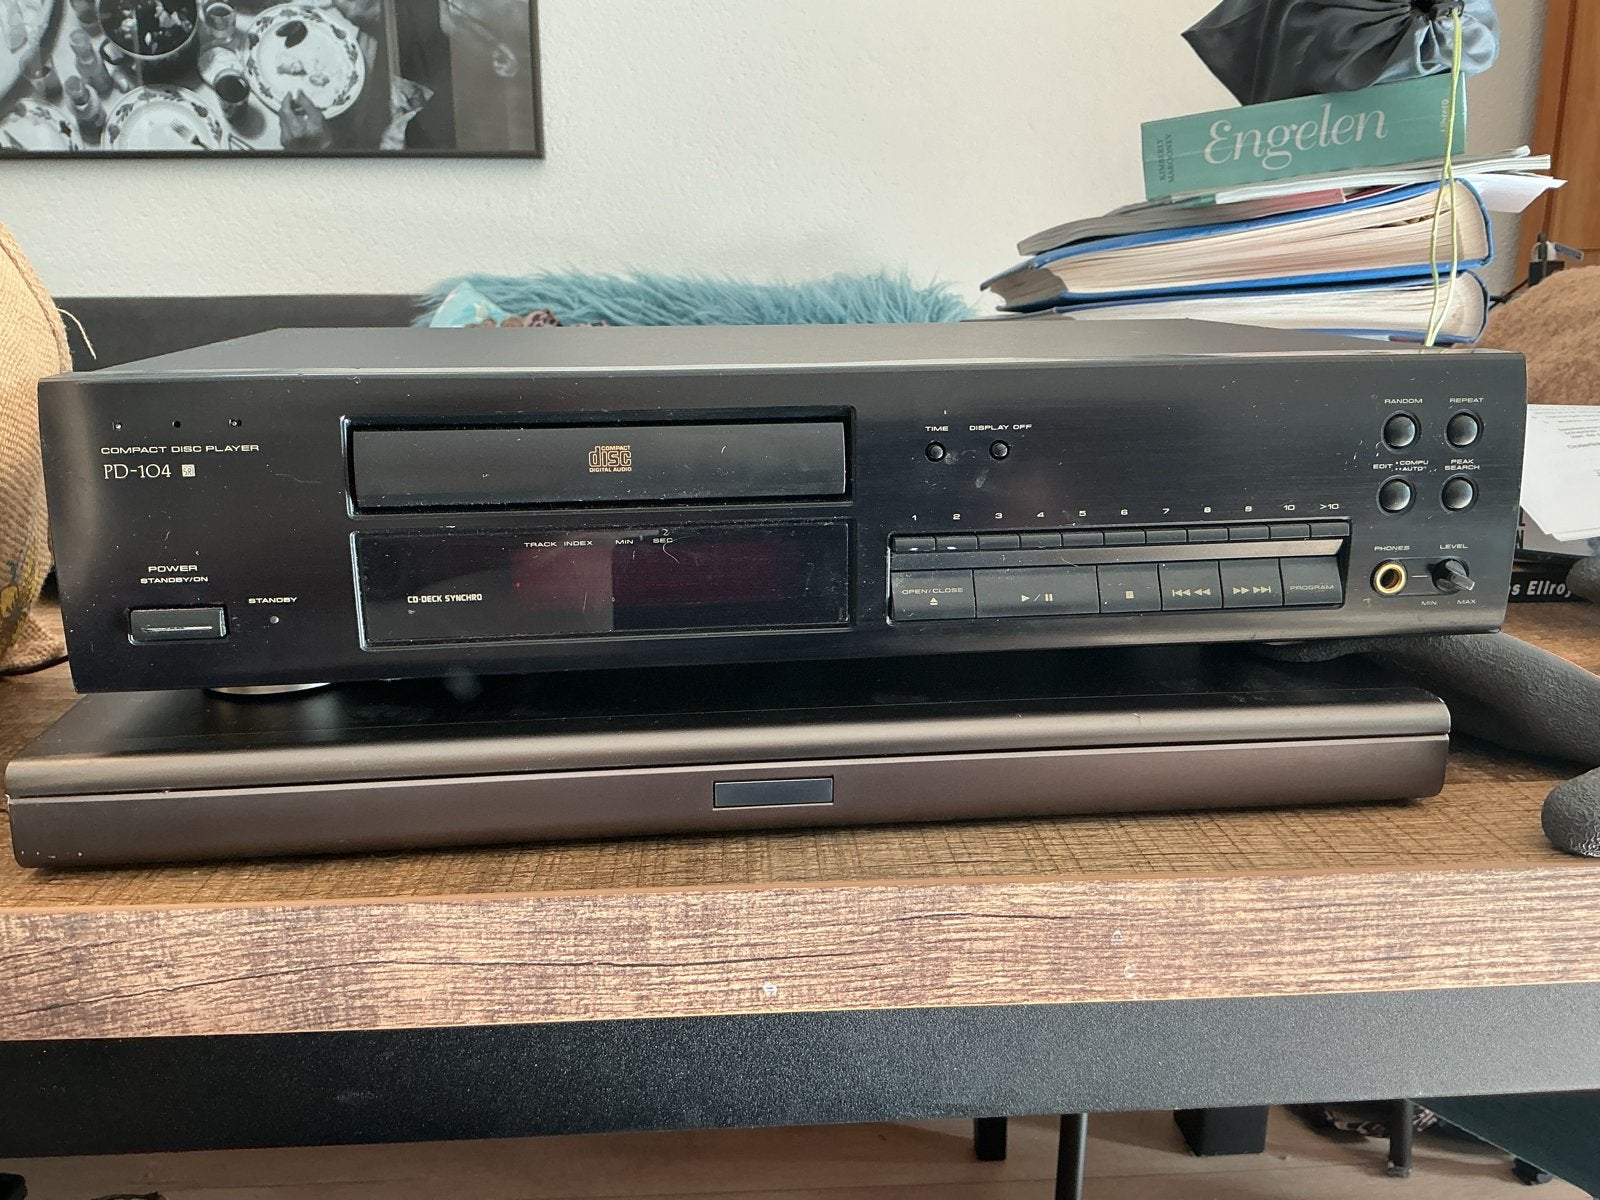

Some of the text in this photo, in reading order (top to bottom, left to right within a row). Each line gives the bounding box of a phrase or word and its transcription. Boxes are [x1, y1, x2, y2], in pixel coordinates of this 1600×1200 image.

[1204, 103, 1388, 170] Engelen
[1156, 137, 1166, 181] KIMBERLY
[1165, 134, 1175, 183] MAROONEY
[101, 446, 167, 454] COMPACT
[171, 445, 202, 453] DISC
[589, 446, 631, 467] disc
[104, 464, 171, 479] PD-104
[1203, 506, 1211, 514] 8
[140, 576, 209, 584] STANDBY/ON
[1526, 580, 1571, 598] Ellro
[407, 593, 483, 603] CD-DECK SYNCHRO
